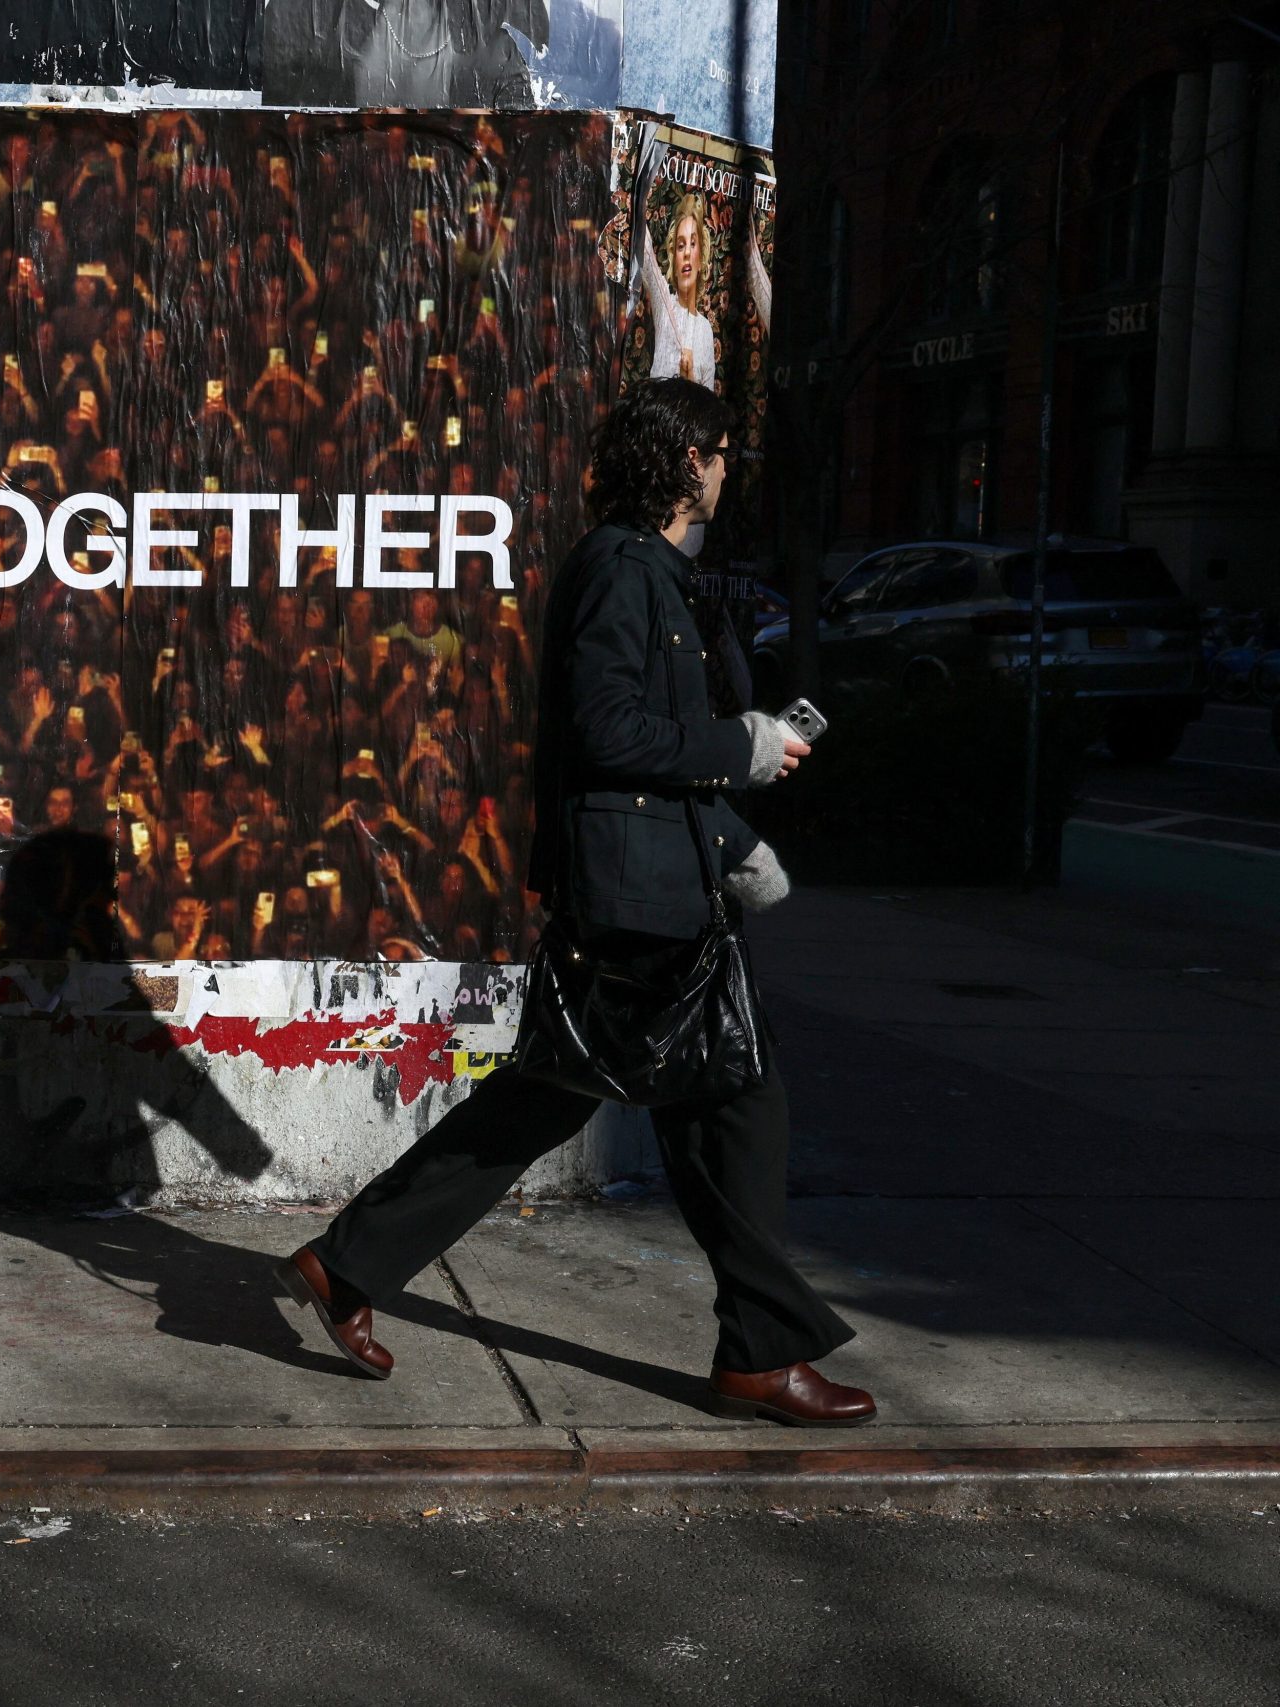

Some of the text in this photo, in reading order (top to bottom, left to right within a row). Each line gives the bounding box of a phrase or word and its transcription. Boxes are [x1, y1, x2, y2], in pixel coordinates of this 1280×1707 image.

[754, 184, 771, 211] THE
[1105, 302, 1149, 336] SKI
[912, 332, 974, 367] CYCLE
